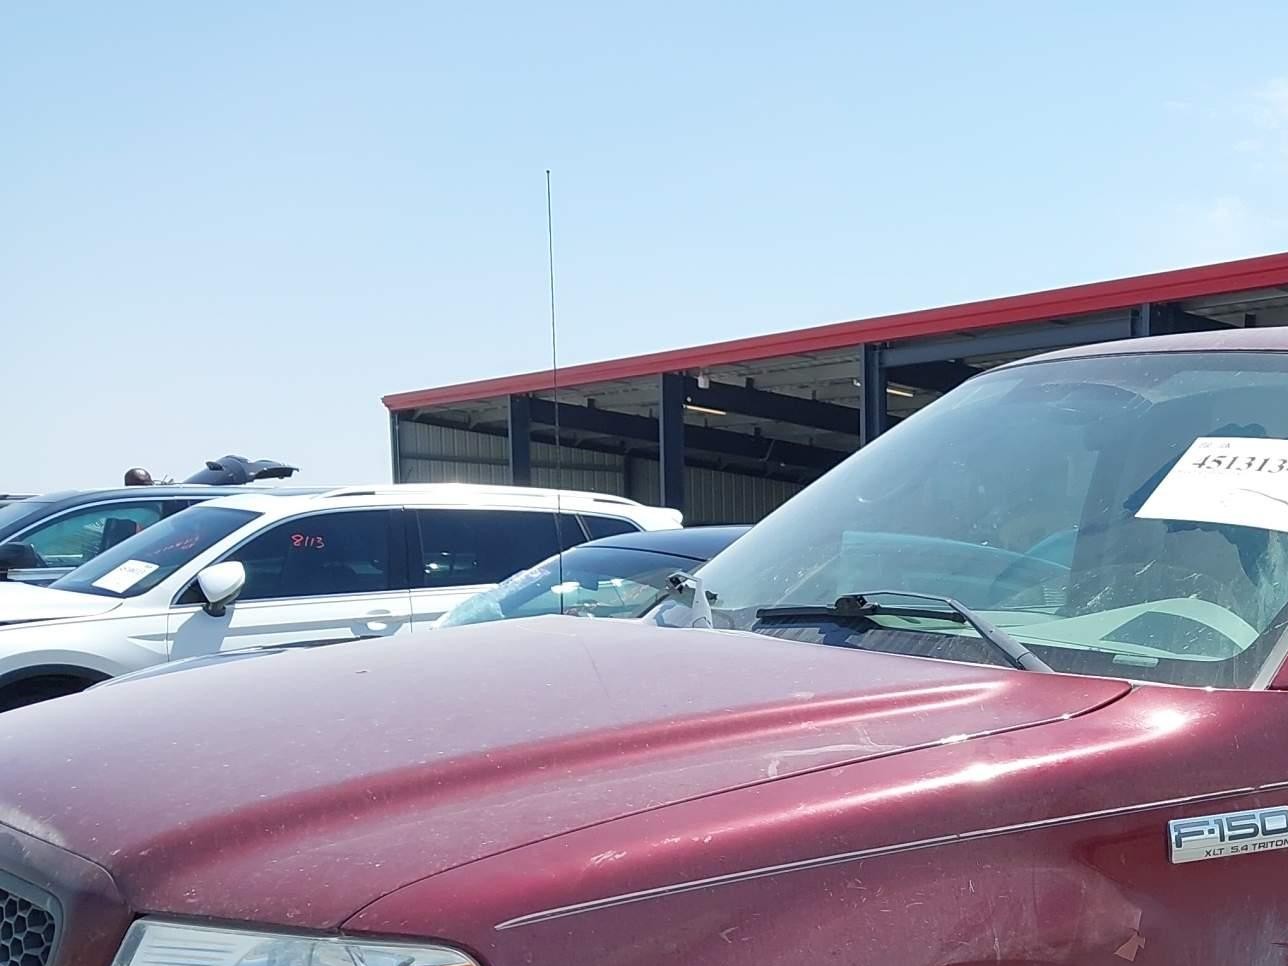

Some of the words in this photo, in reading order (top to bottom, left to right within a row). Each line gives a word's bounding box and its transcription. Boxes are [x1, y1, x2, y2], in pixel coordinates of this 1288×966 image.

[291, 534, 325, 549] 8113
[1204, 847, 1225, 858] XLT
[1230, 844, 1249, 854] 5.4
